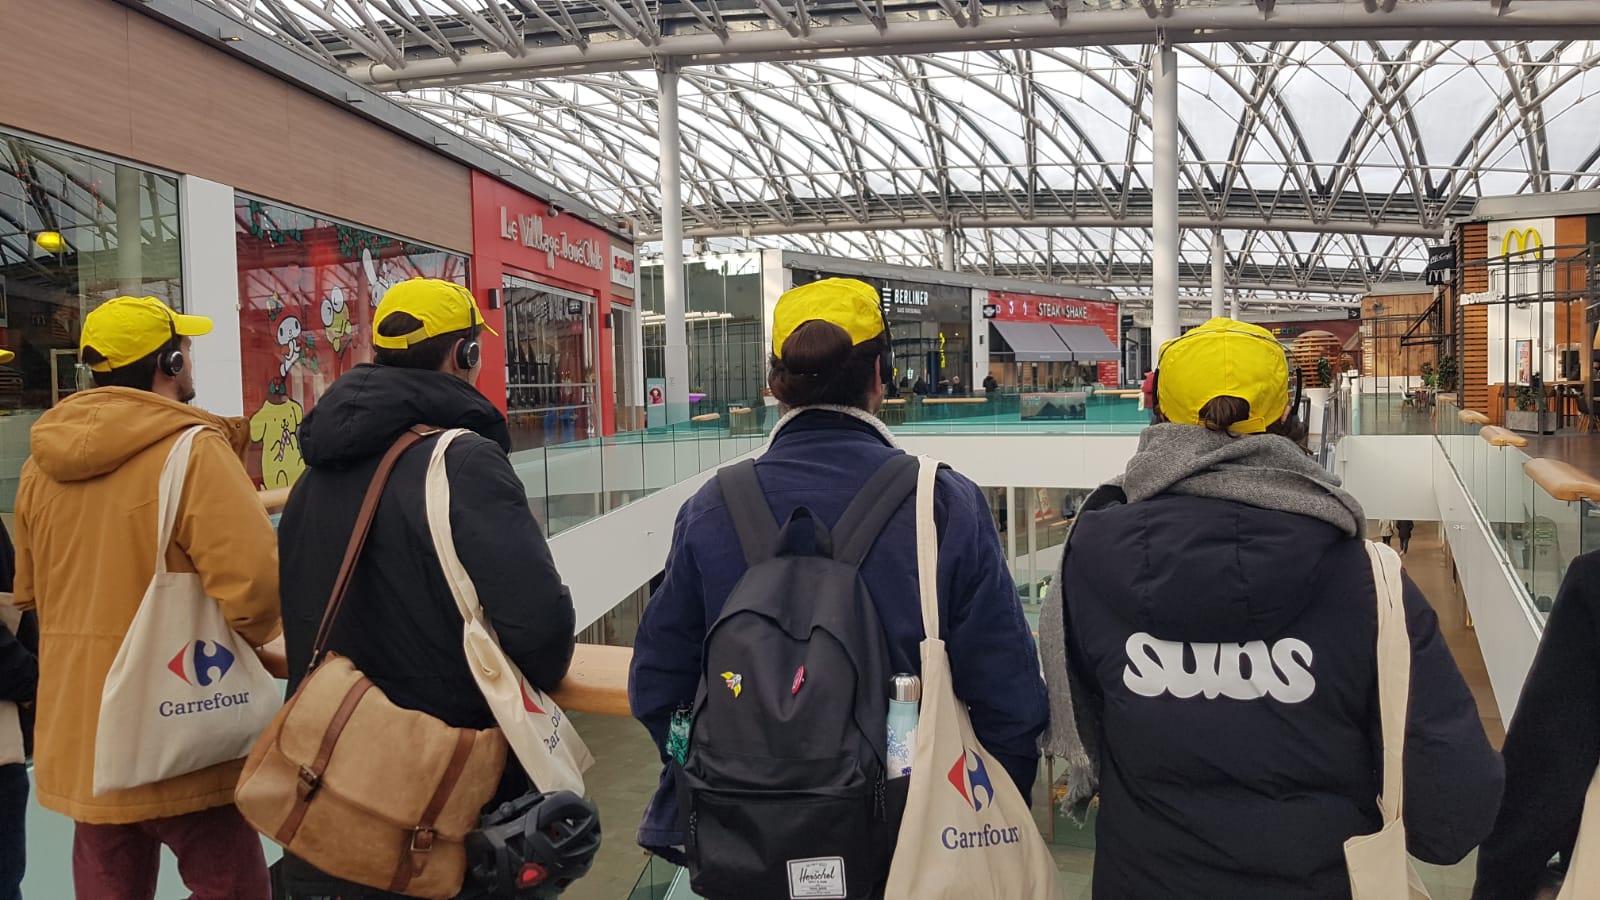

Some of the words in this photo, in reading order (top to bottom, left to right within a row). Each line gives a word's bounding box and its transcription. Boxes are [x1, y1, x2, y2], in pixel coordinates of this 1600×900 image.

[500, 206, 518, 240] Le
[517, 213, 560, 270] Village
[894, 288, 929, 306] BERLINER
[1038, 302, 1060, 317] STEAK
[1065, 304, 1088, 319] SHAKE
[159, 691, 250, 717] Carrefour
[799, 866, 834, 883] Herschel
